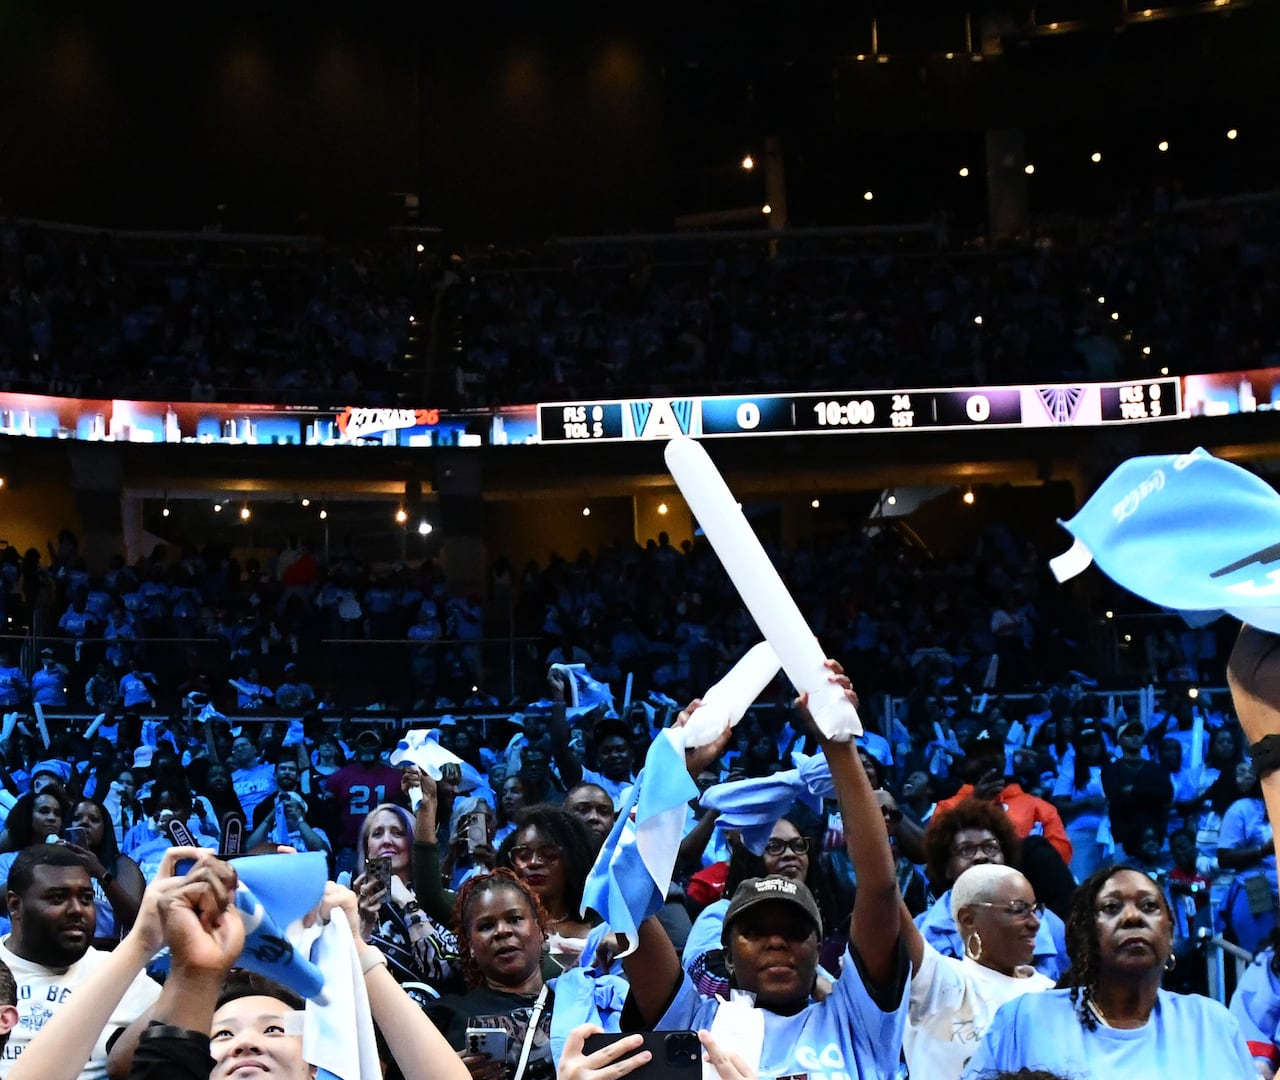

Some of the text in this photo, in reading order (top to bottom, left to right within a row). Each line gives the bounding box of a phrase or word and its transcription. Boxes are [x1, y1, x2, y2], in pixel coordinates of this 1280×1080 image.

[891, 394, 910, 410] 24
[1120, 384, 1161, 402] FLS 0
[563, 405, 603, 423] FLS 0
[735, 402, 761, 430] 0
[813, 401, 875, 426] 10:00
[966, 395, 990, 421] 0
[1120, 400, 1161, 419] TOL 5
[348, 407, 417, 432] FINALS
[890, 411, 914, 427] 1ST
[564, 421, 603, 439] TOL 5
[349, 784, 386, 814] 21
[755, 879, 797, 893] break up
[778, 886, 797, 895] him
[795, 1042, 845, 1070] GO
